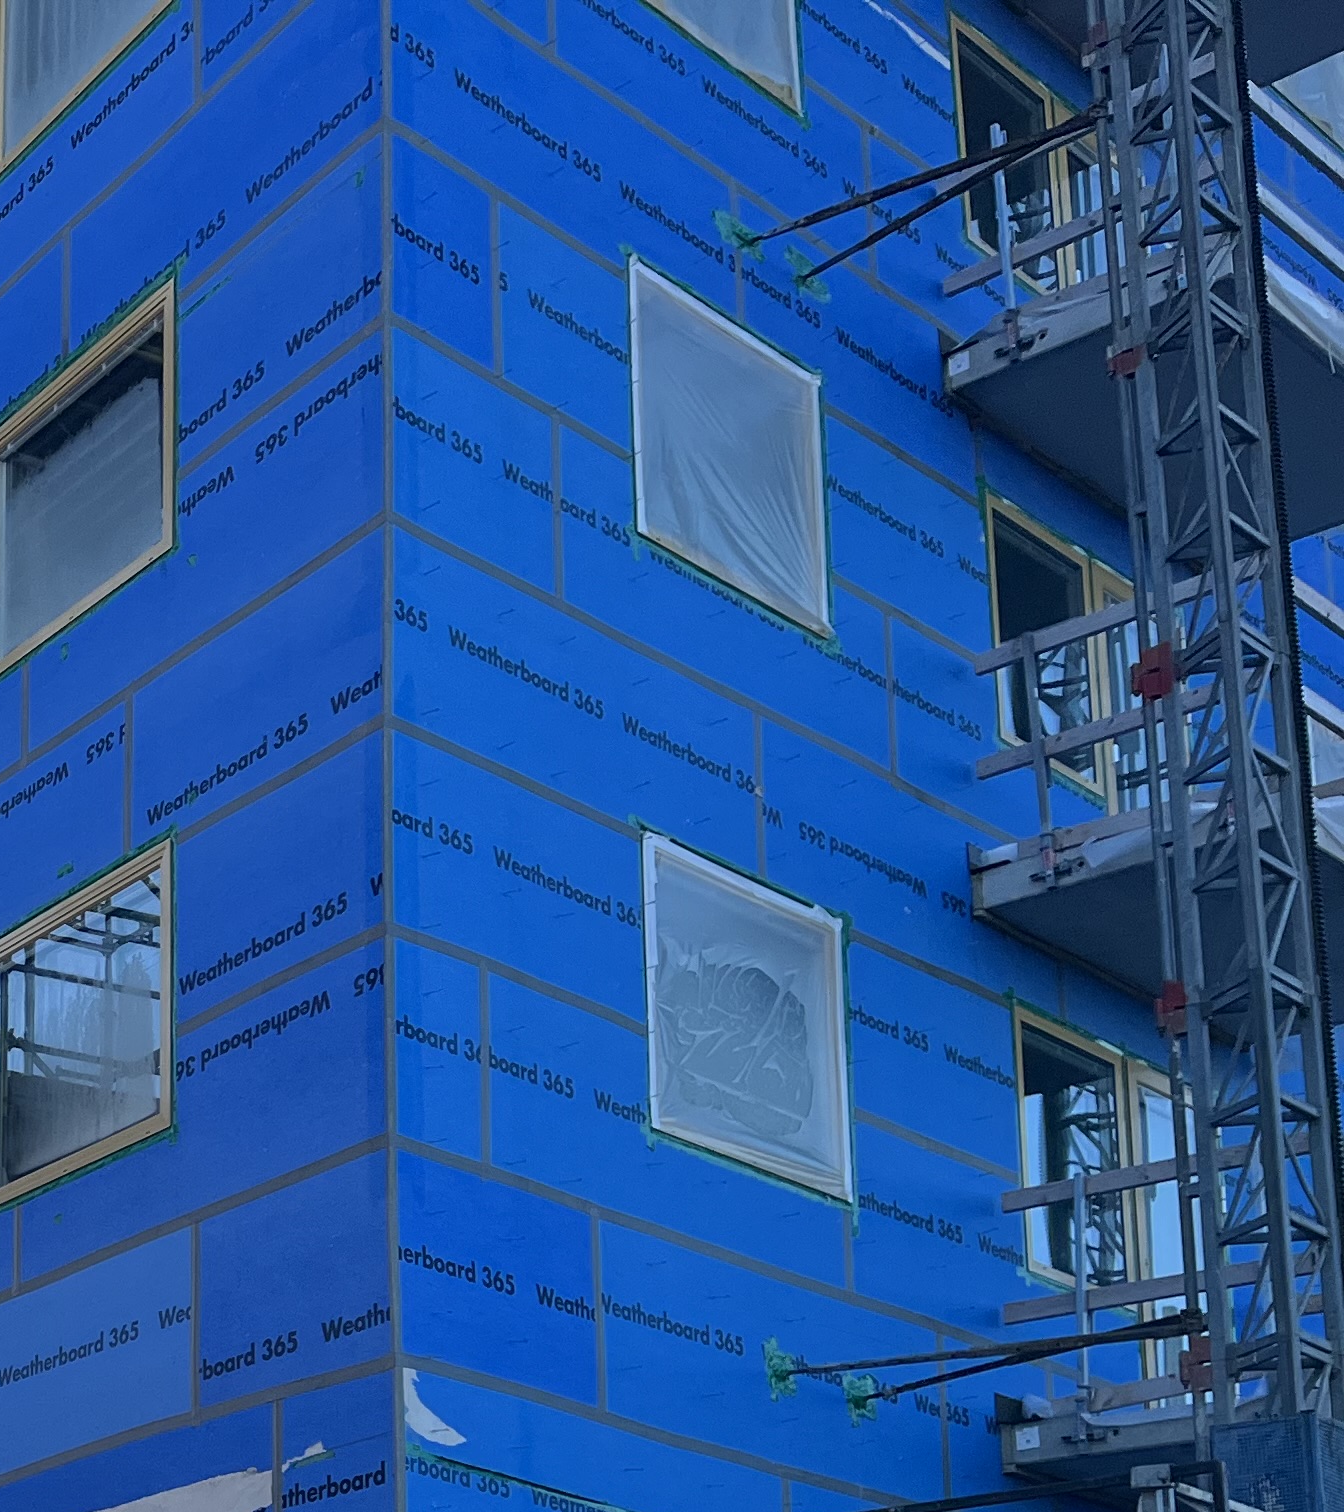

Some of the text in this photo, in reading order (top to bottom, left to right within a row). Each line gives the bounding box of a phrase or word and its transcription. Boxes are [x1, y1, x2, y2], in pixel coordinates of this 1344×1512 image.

[658, 45, 687, 77] 365
[70, 36, 177, 150] Weatherboard
[405, 33, 602, 183] 365 Weatherboard 365
[245, 77, 374, 204] Weatherboard
[702, 74, 828, 179] Weatherboard 365
[27, 156, 54, 193] 365
[194, 209, 227, 249] 365
[619, 180, 724, 265] Weatherboard
[449, 251, 480, 285] 365
[794, 300, 930, 400] 365 Weatherboard
[232, 360, 265, 401] 365
[255, 425, 288, 464] 365
[451, 430, 483, 464] 365
[601, 516, 632, 548] 365
[826, 474, 945, 558] Weatherboard 365
[394, 599, 732, 784] 365 Weatherboard 365 Weatherboard
[958, 711, 982, 742] 365
[86, 729, 114, 766] 365
[146, 712, 309, 826] Weatherboard 365
[440, 824, 612, 920] 365 Weatherboard
[798, 819, 928, 900] Weatherboard 365
[178, 891, 348, 996] Weatherboard 365
[201, 991, 331, 1072] Weatherboard
[903, 1023, 930, 1054] 365
[542, 1065, 576, 1100] 365
[937, 1215, 964, 1244] 365
[482, 1265, 516, 1297] 365
[109, 1321, 140, 1348] 365
[262, 1331, 298, 1361] 365
[715, 1326, 745, 1356] 365
[947, 1402, 971, 1427] 365
[478, 1469, 512, 1501] 365
